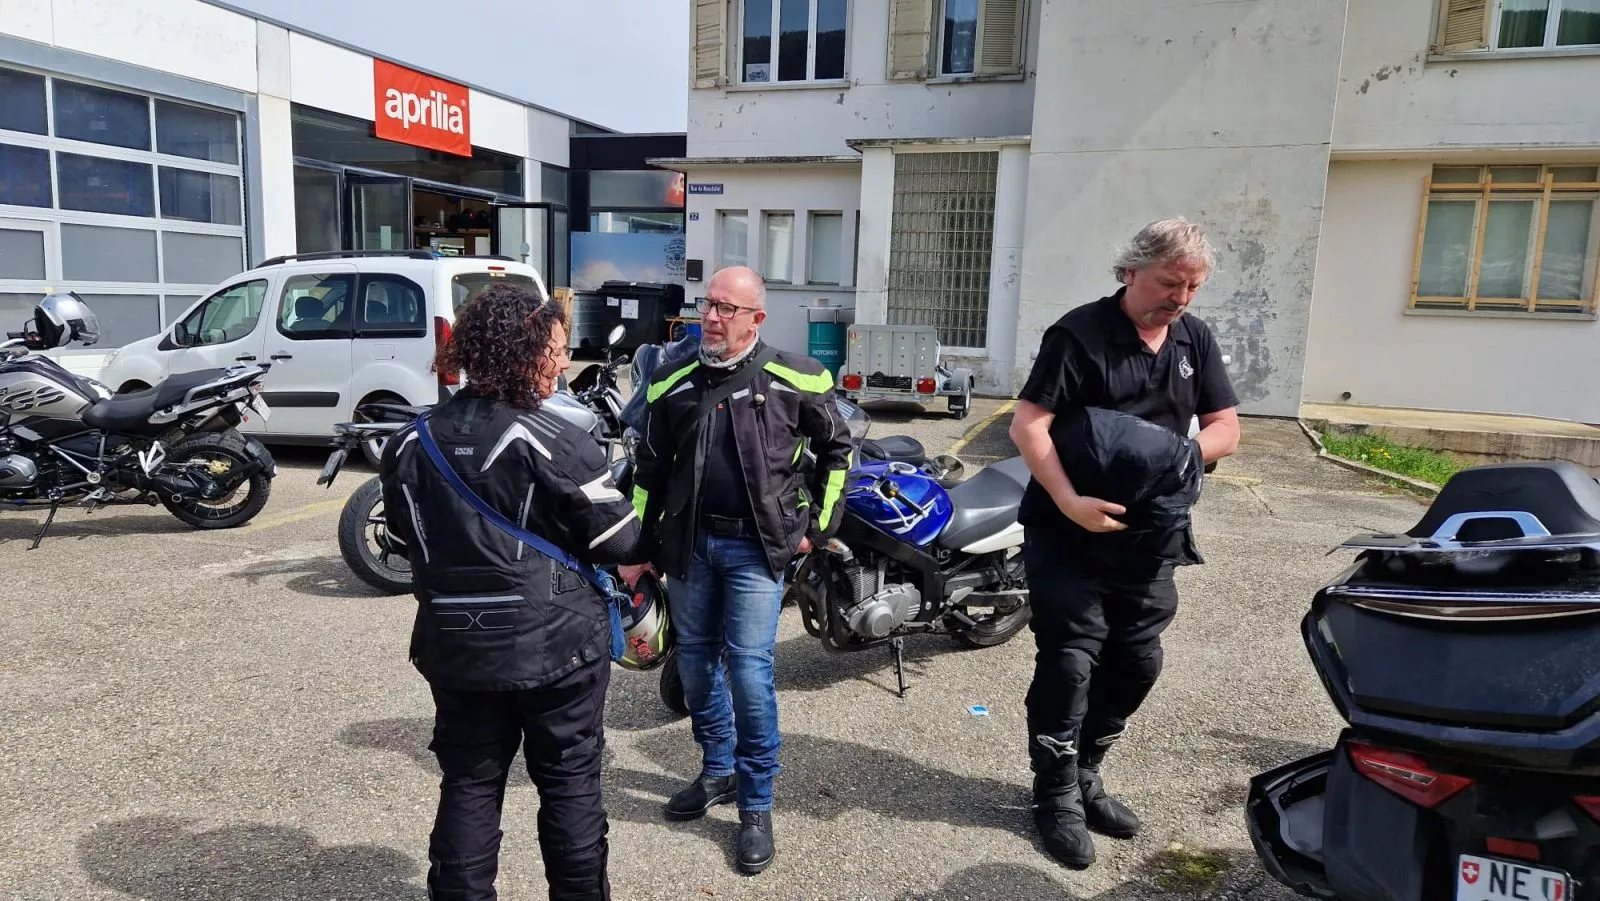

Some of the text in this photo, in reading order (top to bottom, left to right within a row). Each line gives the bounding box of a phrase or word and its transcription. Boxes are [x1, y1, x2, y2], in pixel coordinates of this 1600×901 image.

[385, 88, 464, 134] aprilia
[690, 212, 699, 220] 32
[1489, 861, 1531, 901] NE
